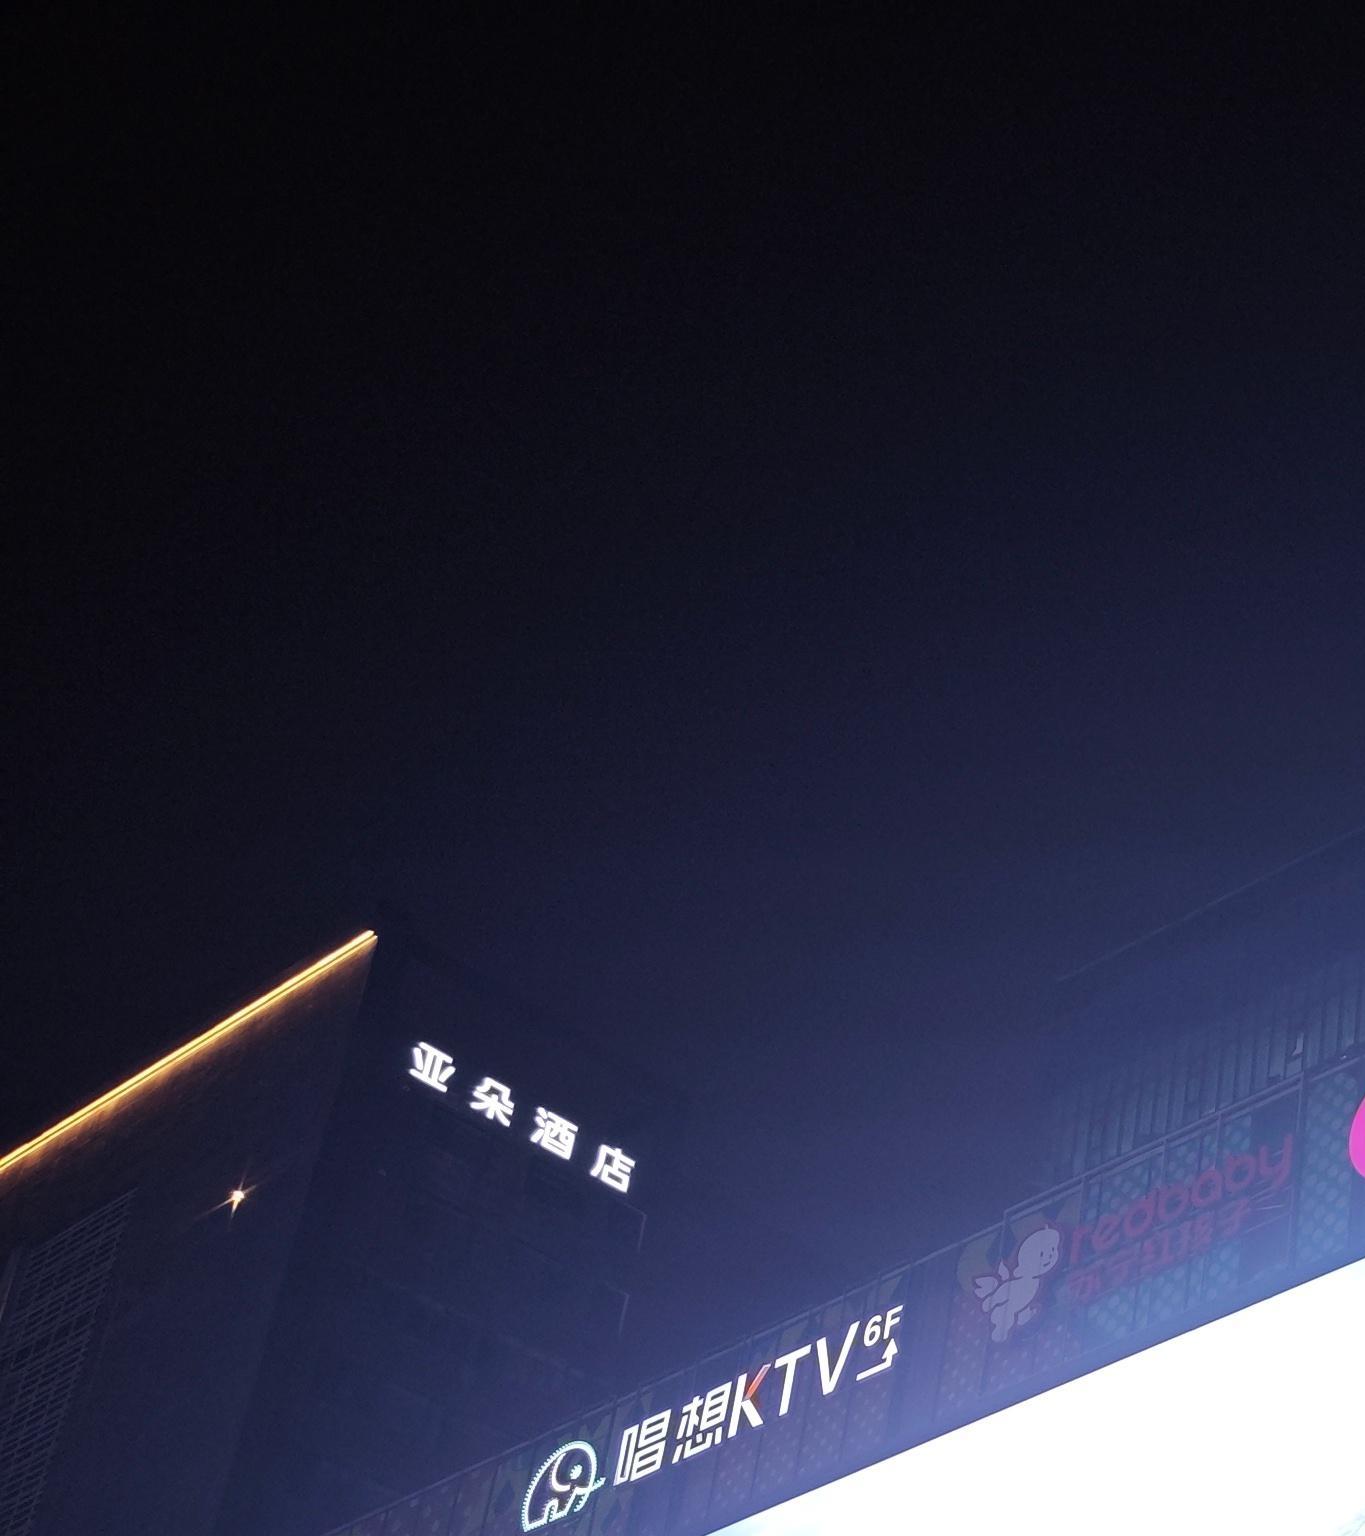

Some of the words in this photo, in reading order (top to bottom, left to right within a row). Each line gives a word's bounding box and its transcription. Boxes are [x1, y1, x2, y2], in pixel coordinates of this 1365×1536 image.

[410, 1042, 636, 1194] 亚朵酒店
[1070, 1134, 1293, 1264] redbaby
[863, 1305, 904, 1347] 6F
